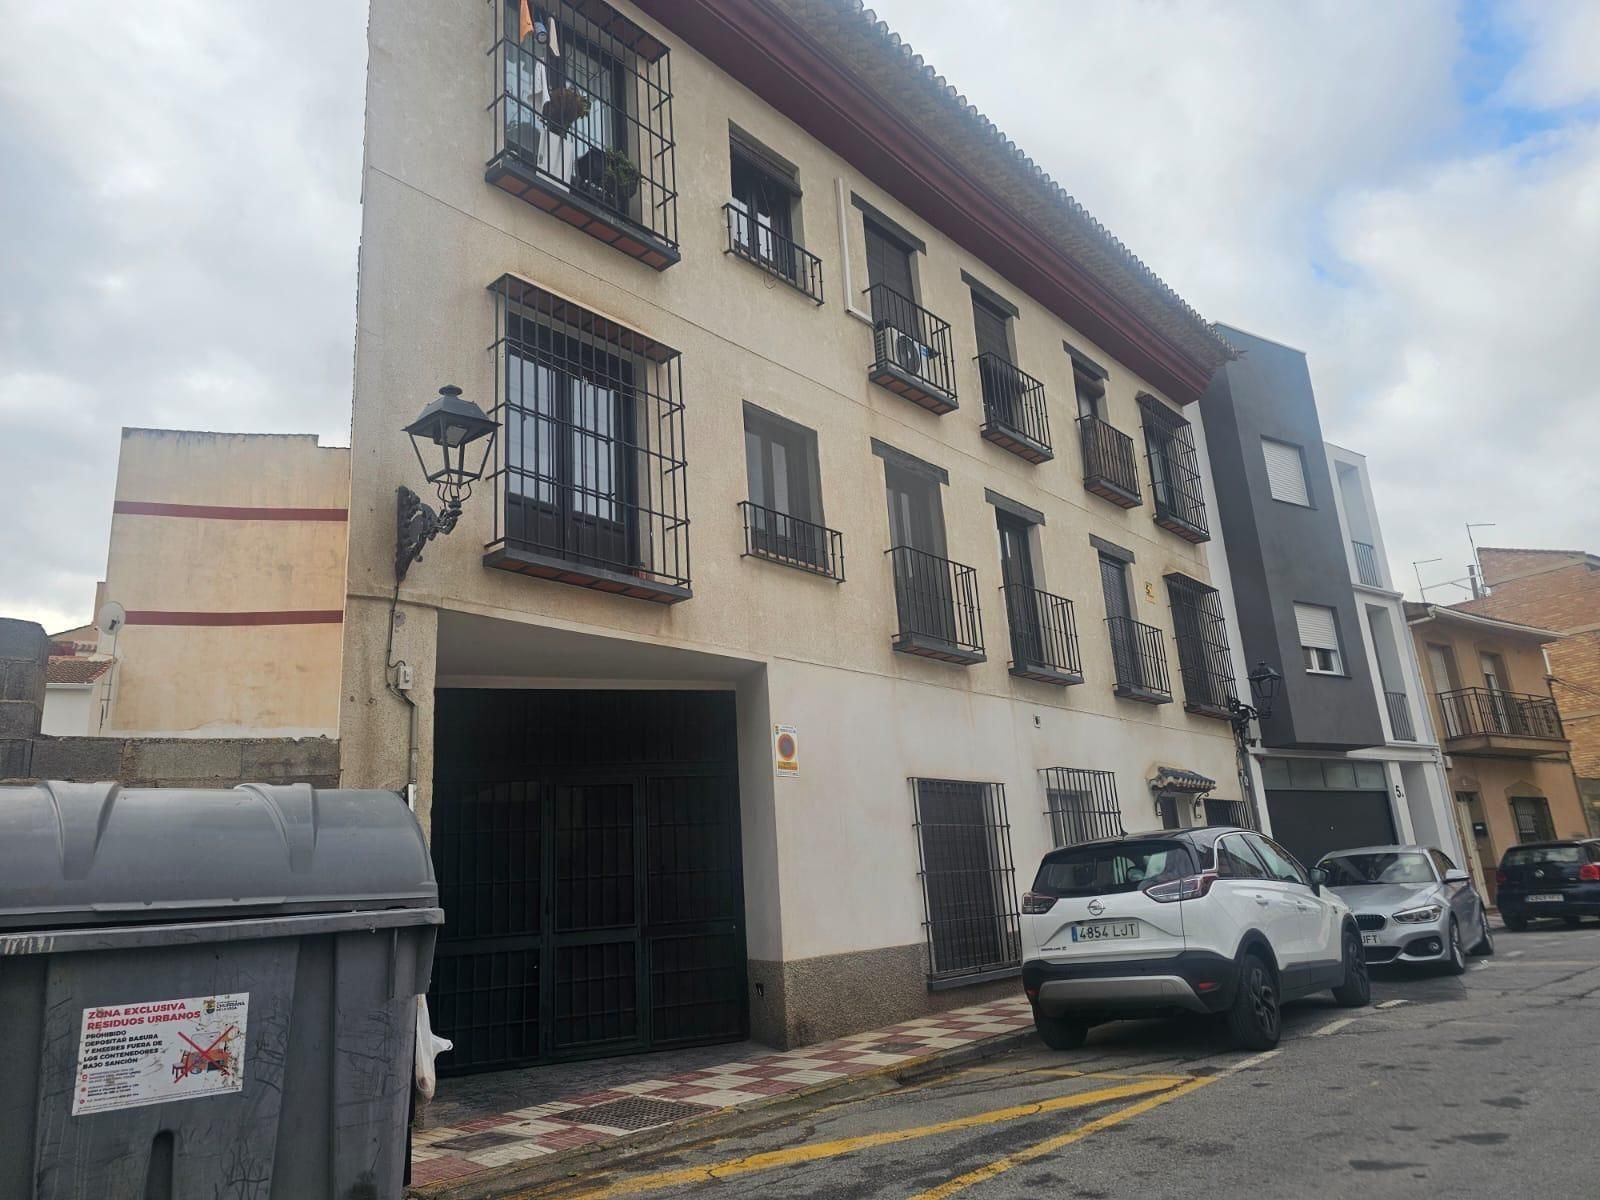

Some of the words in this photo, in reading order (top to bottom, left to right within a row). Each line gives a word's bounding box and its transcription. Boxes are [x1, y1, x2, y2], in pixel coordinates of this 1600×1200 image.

[1079, 925, 1109, 940] 4854
[1112, 923, 1136, 937] LJT
[87, 1009, 121, 1020] ZONA
[124, 1002, 186, 1016] EXCLUSIVA
[87, 1017, 145, 1031] RESIDUOS
[147, 1010, 201, 1024] URBANOS
[84, 1037, 127, 1047] DEPOSITAR
[128, 1033, 159, 1042] BASURA
[86, 1030, 127, 1040] PROHIBIDO
[126, 1041, 151, 1049] FUERA
[99, 1048, 159, 1060] CONTENEDORES
[82, 1062, 104, 1070] BAJO
[104, 1057, 138, 1067] SANCIÓN
